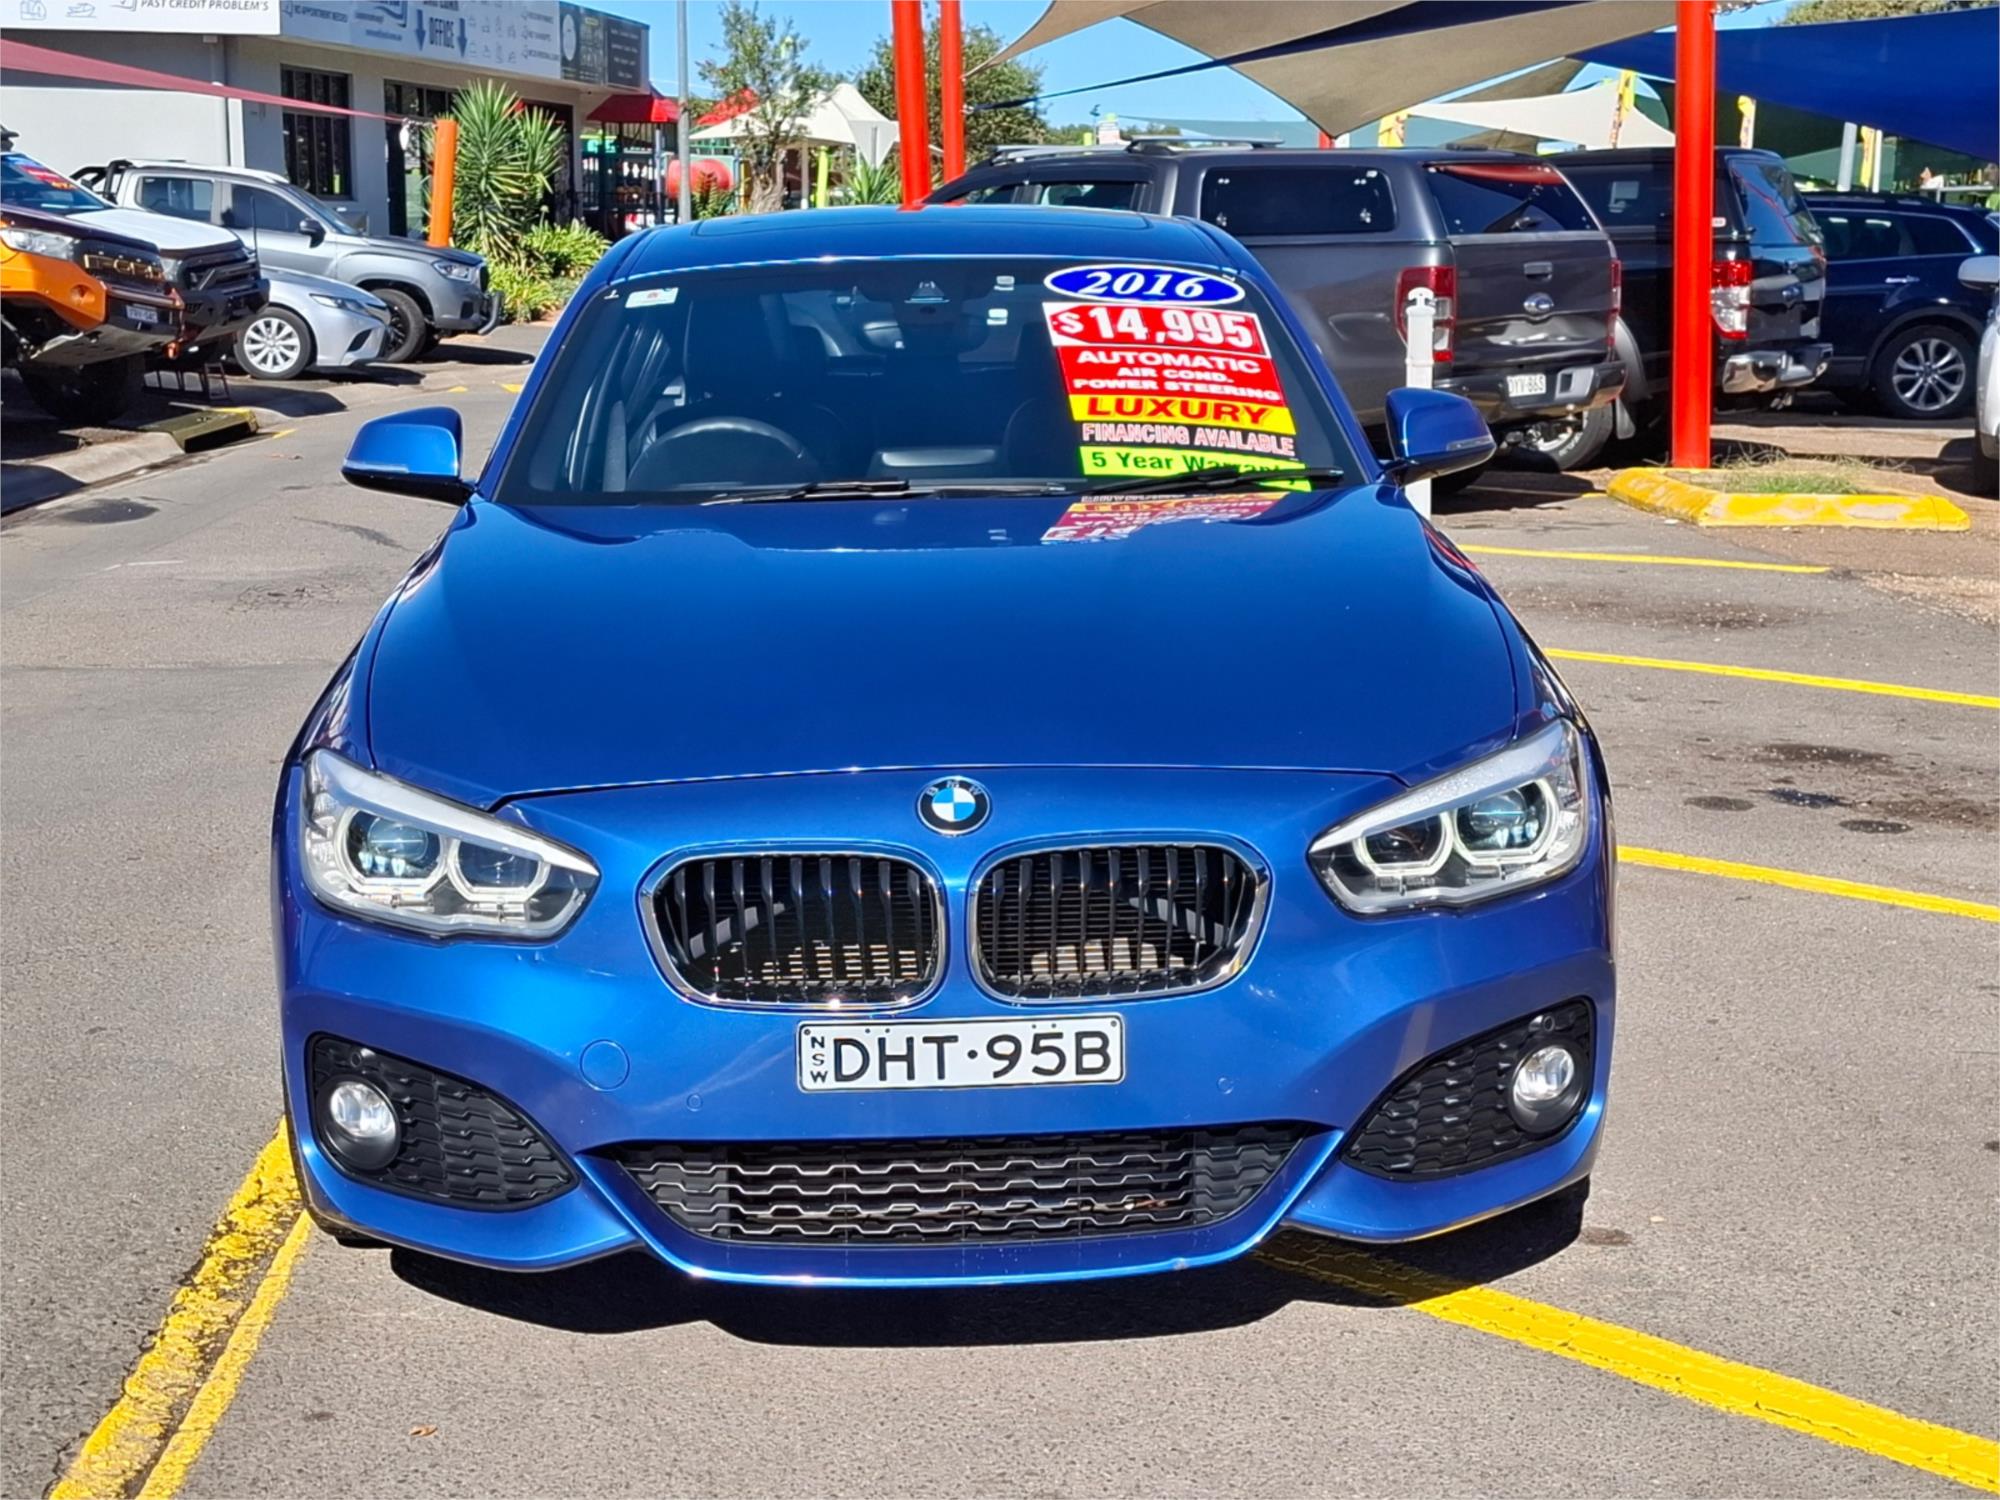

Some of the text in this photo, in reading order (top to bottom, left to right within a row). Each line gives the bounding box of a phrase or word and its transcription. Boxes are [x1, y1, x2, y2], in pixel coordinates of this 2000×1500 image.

[141, 0, 270, 11] PAST CREDIT PROBLEM'S
[429, 17, 455, 49] OFFICE
[1078, 271, 1205, 297] 2016
[1056, 307, 1254, 349] $14,995
[1077, 350, 1261, 374] AUTOMATIC
[1117, 367, 1235, 383] AIR COND.
[1073, 379, 1280, 401] POWER STEERING
[1087, 397, 1271, 424] LUXURY
[1082, 423, 1296, 456] FINANCING AVAILABLE
[1091, 452, 1106, 468] 5
[1116, 452, 1173, 471] Year
[926, 780, 983, 797] BMW
